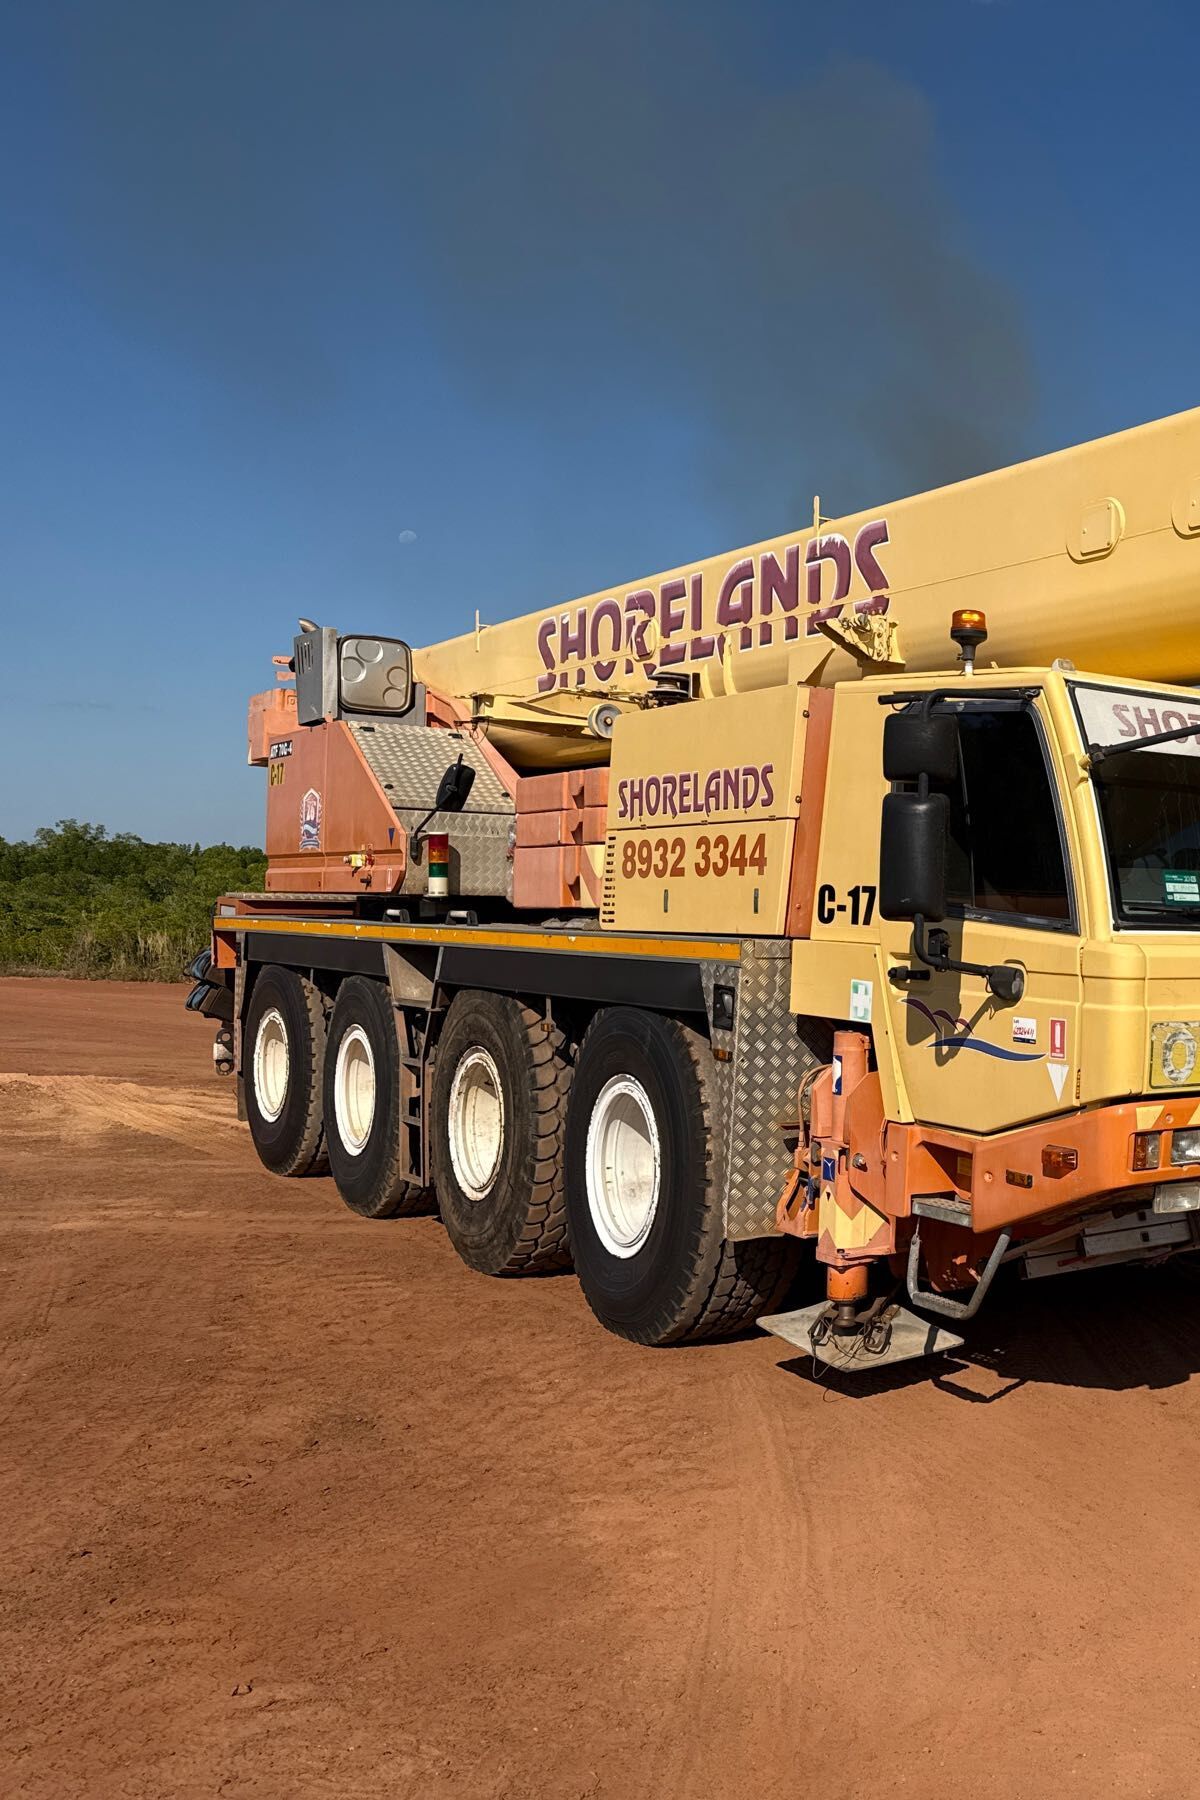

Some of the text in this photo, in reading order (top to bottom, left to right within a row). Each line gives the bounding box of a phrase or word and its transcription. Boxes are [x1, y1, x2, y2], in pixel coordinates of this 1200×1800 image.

[536, 518, 890, 694] SHORELANDS
[270, 763, 284, 785] C-17
[618, 763, 774, 821] SHORELANDS
[621, 833, 767, 879] 8932 3344
[817, 884, 877, 926] C-17
